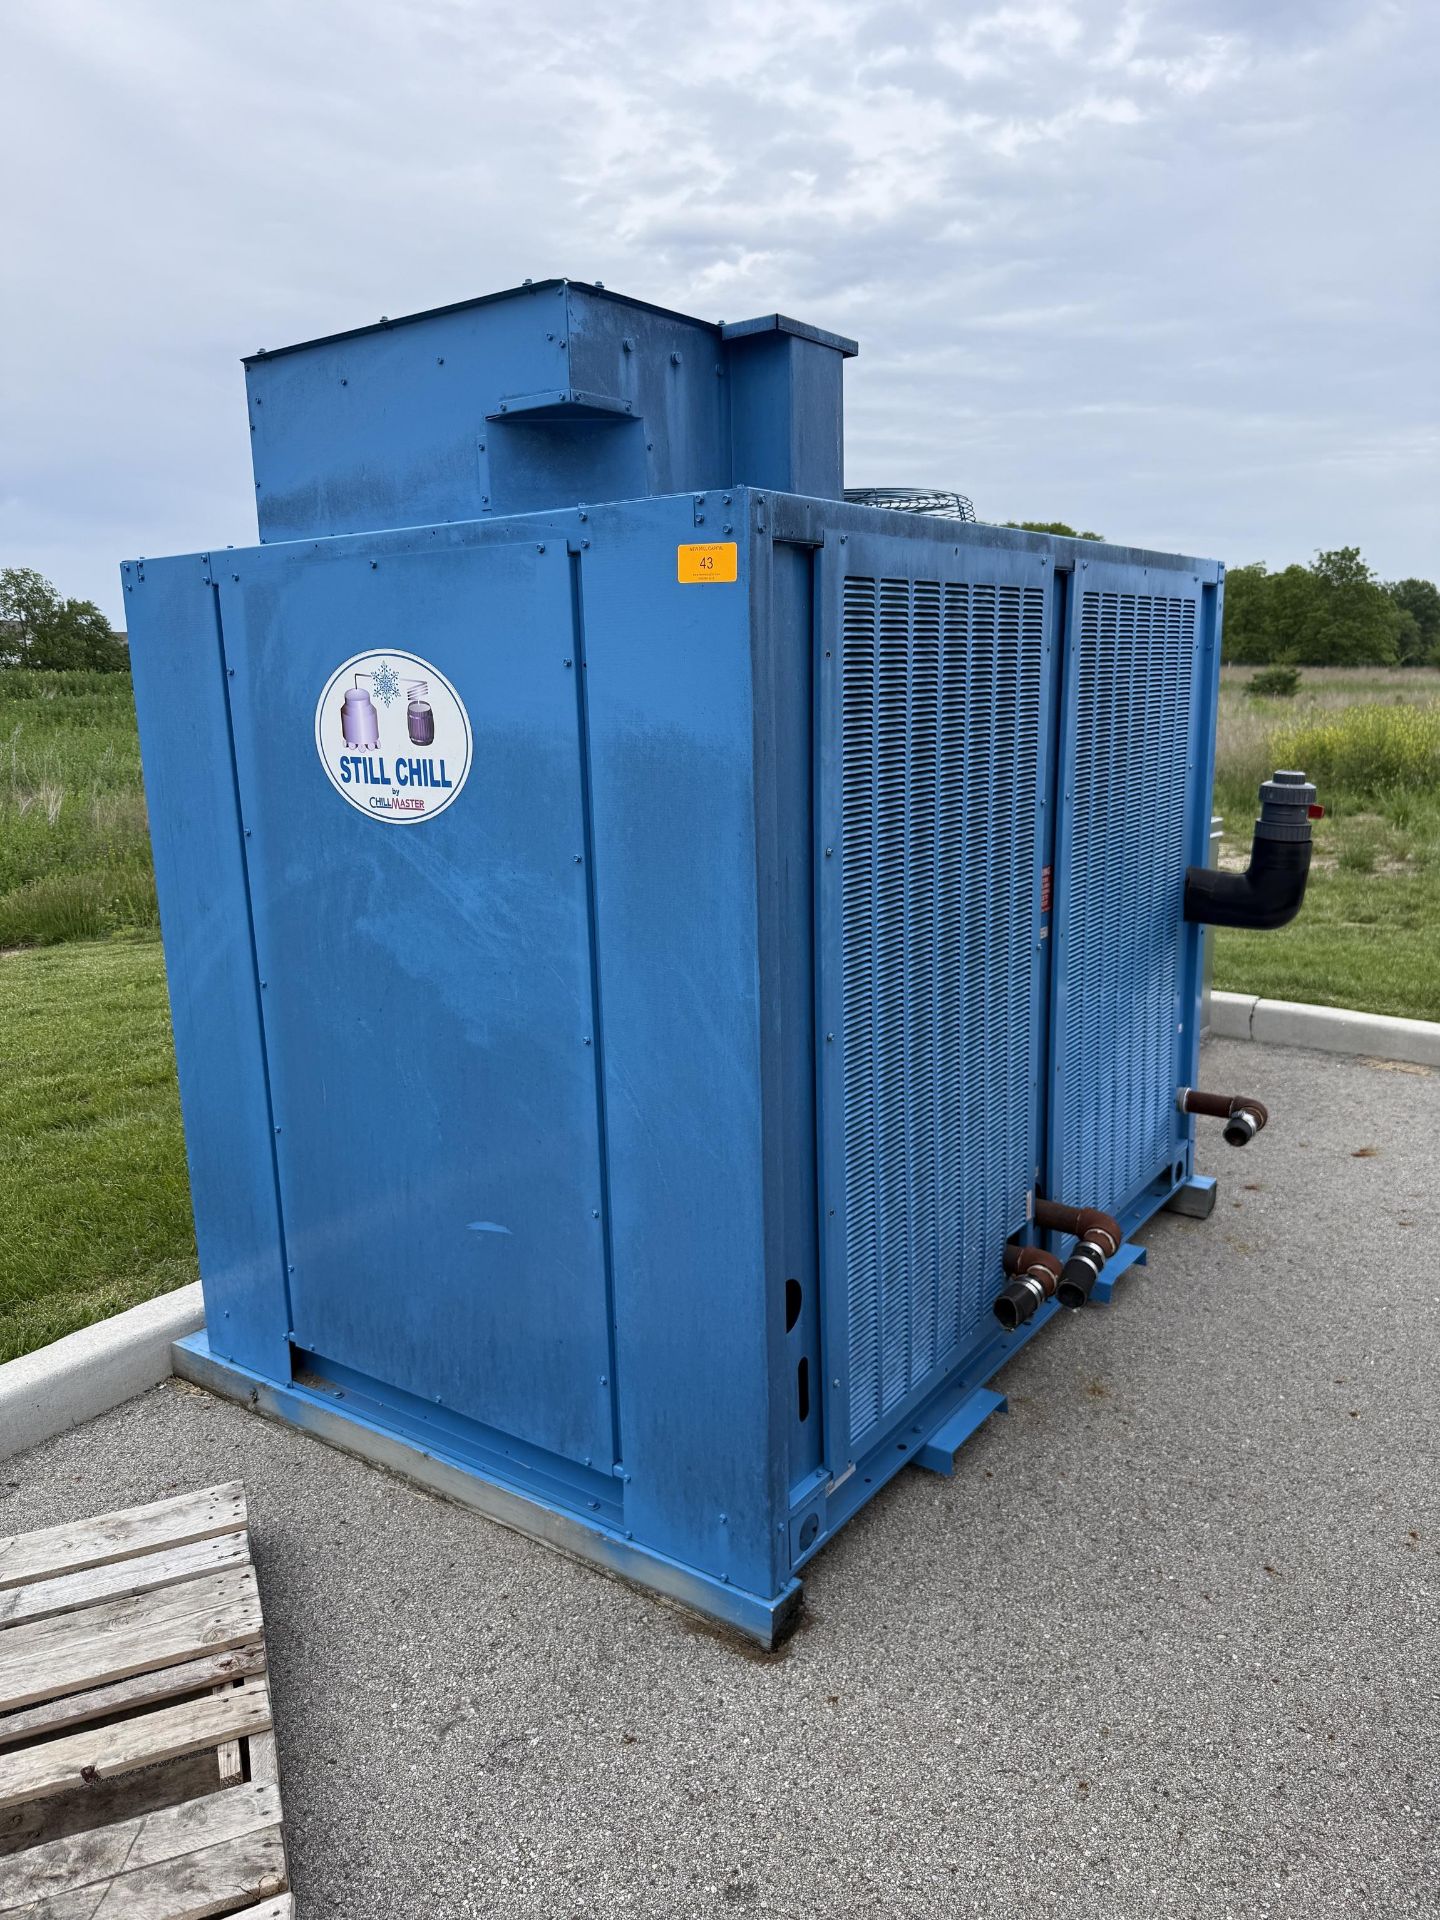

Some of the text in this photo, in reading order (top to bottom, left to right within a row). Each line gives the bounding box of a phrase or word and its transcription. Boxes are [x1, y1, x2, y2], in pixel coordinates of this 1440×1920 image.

[699, 556, 714, 570] 43
[339, 755, 453, 788] STILL CHILL
[391, 788, 400, 796] by
